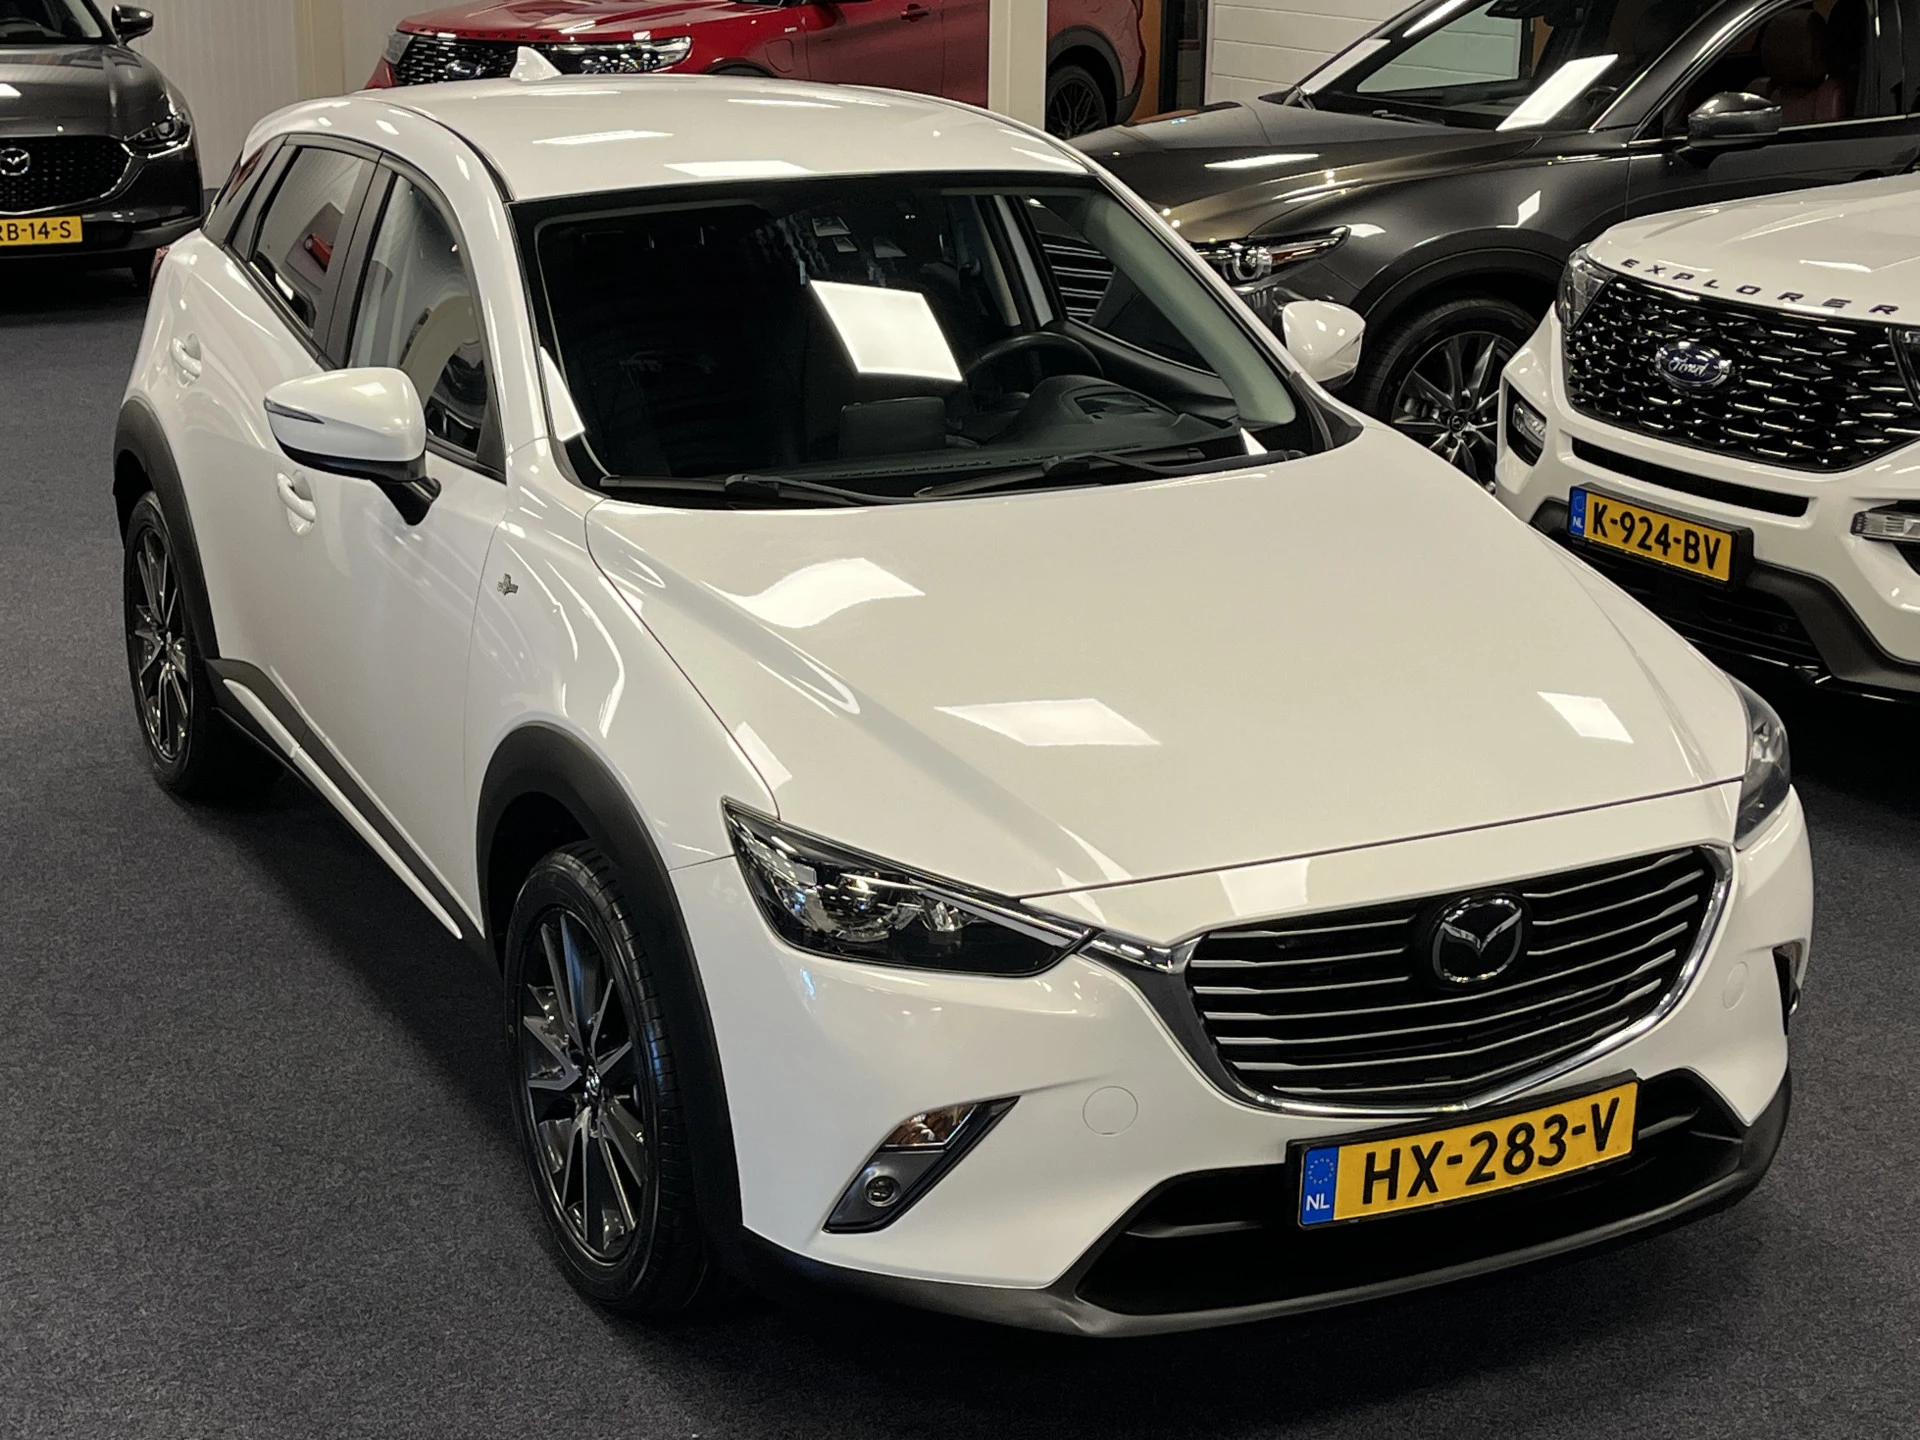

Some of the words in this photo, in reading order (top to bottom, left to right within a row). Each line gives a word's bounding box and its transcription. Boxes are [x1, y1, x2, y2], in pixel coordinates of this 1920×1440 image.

[1620, 258, 1899, 315] EXPLORER
[1668, 357, 1709, 377] Ford
[1572, 516, 1583, 529] NL
[1593, 502, 1721, 570] K-924-BV
[1362, 1097, 1620, 1204] HX-283-V
[1306, 1194, 1330, 1211] NL
